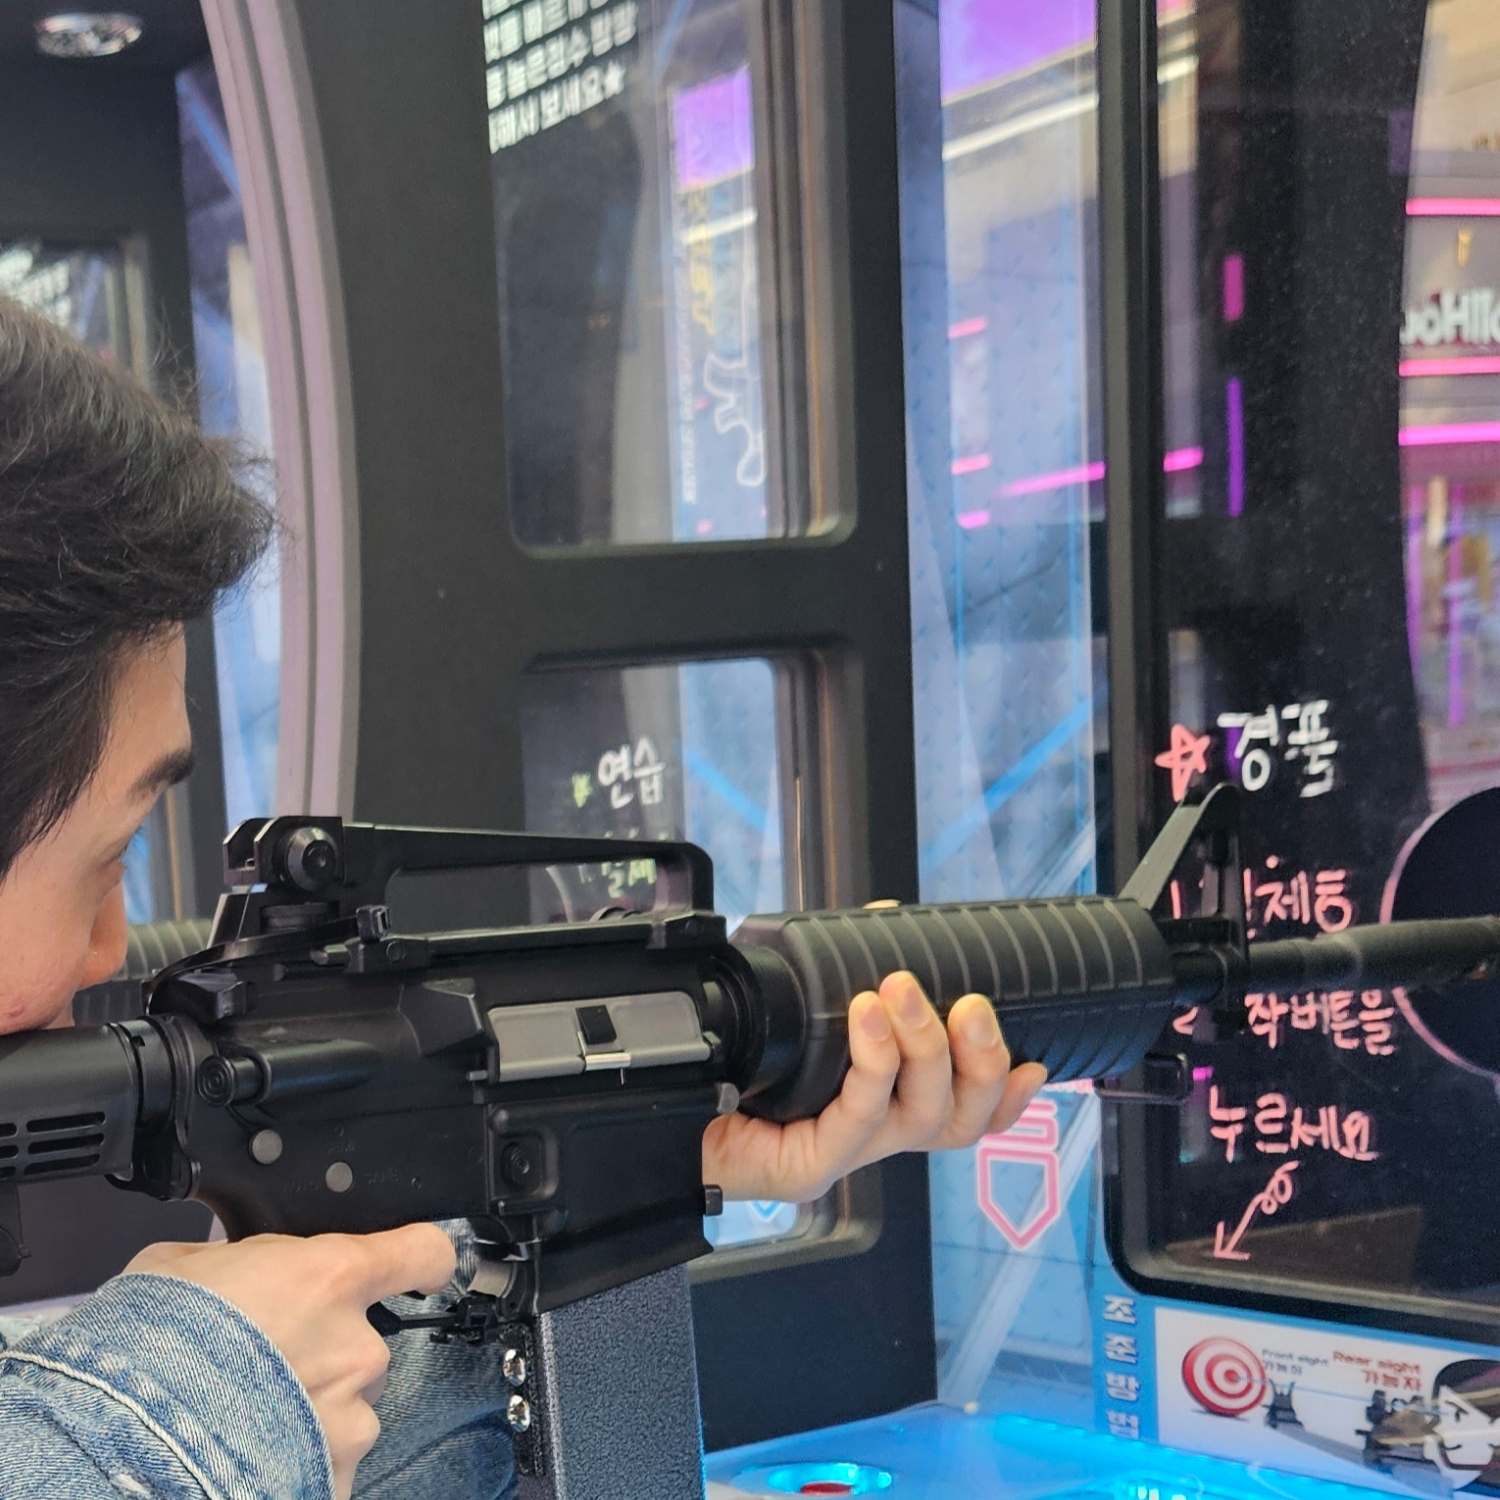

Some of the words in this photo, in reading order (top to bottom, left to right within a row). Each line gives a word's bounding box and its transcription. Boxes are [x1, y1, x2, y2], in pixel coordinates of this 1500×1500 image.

[597, 734, 666, 810] 연습
[1244, 990, 1395, 1055] 작버튼을
[1210, 1086, 1378, 1163] 누르세요
[1333, 1350, 1371, 1366] Rear
